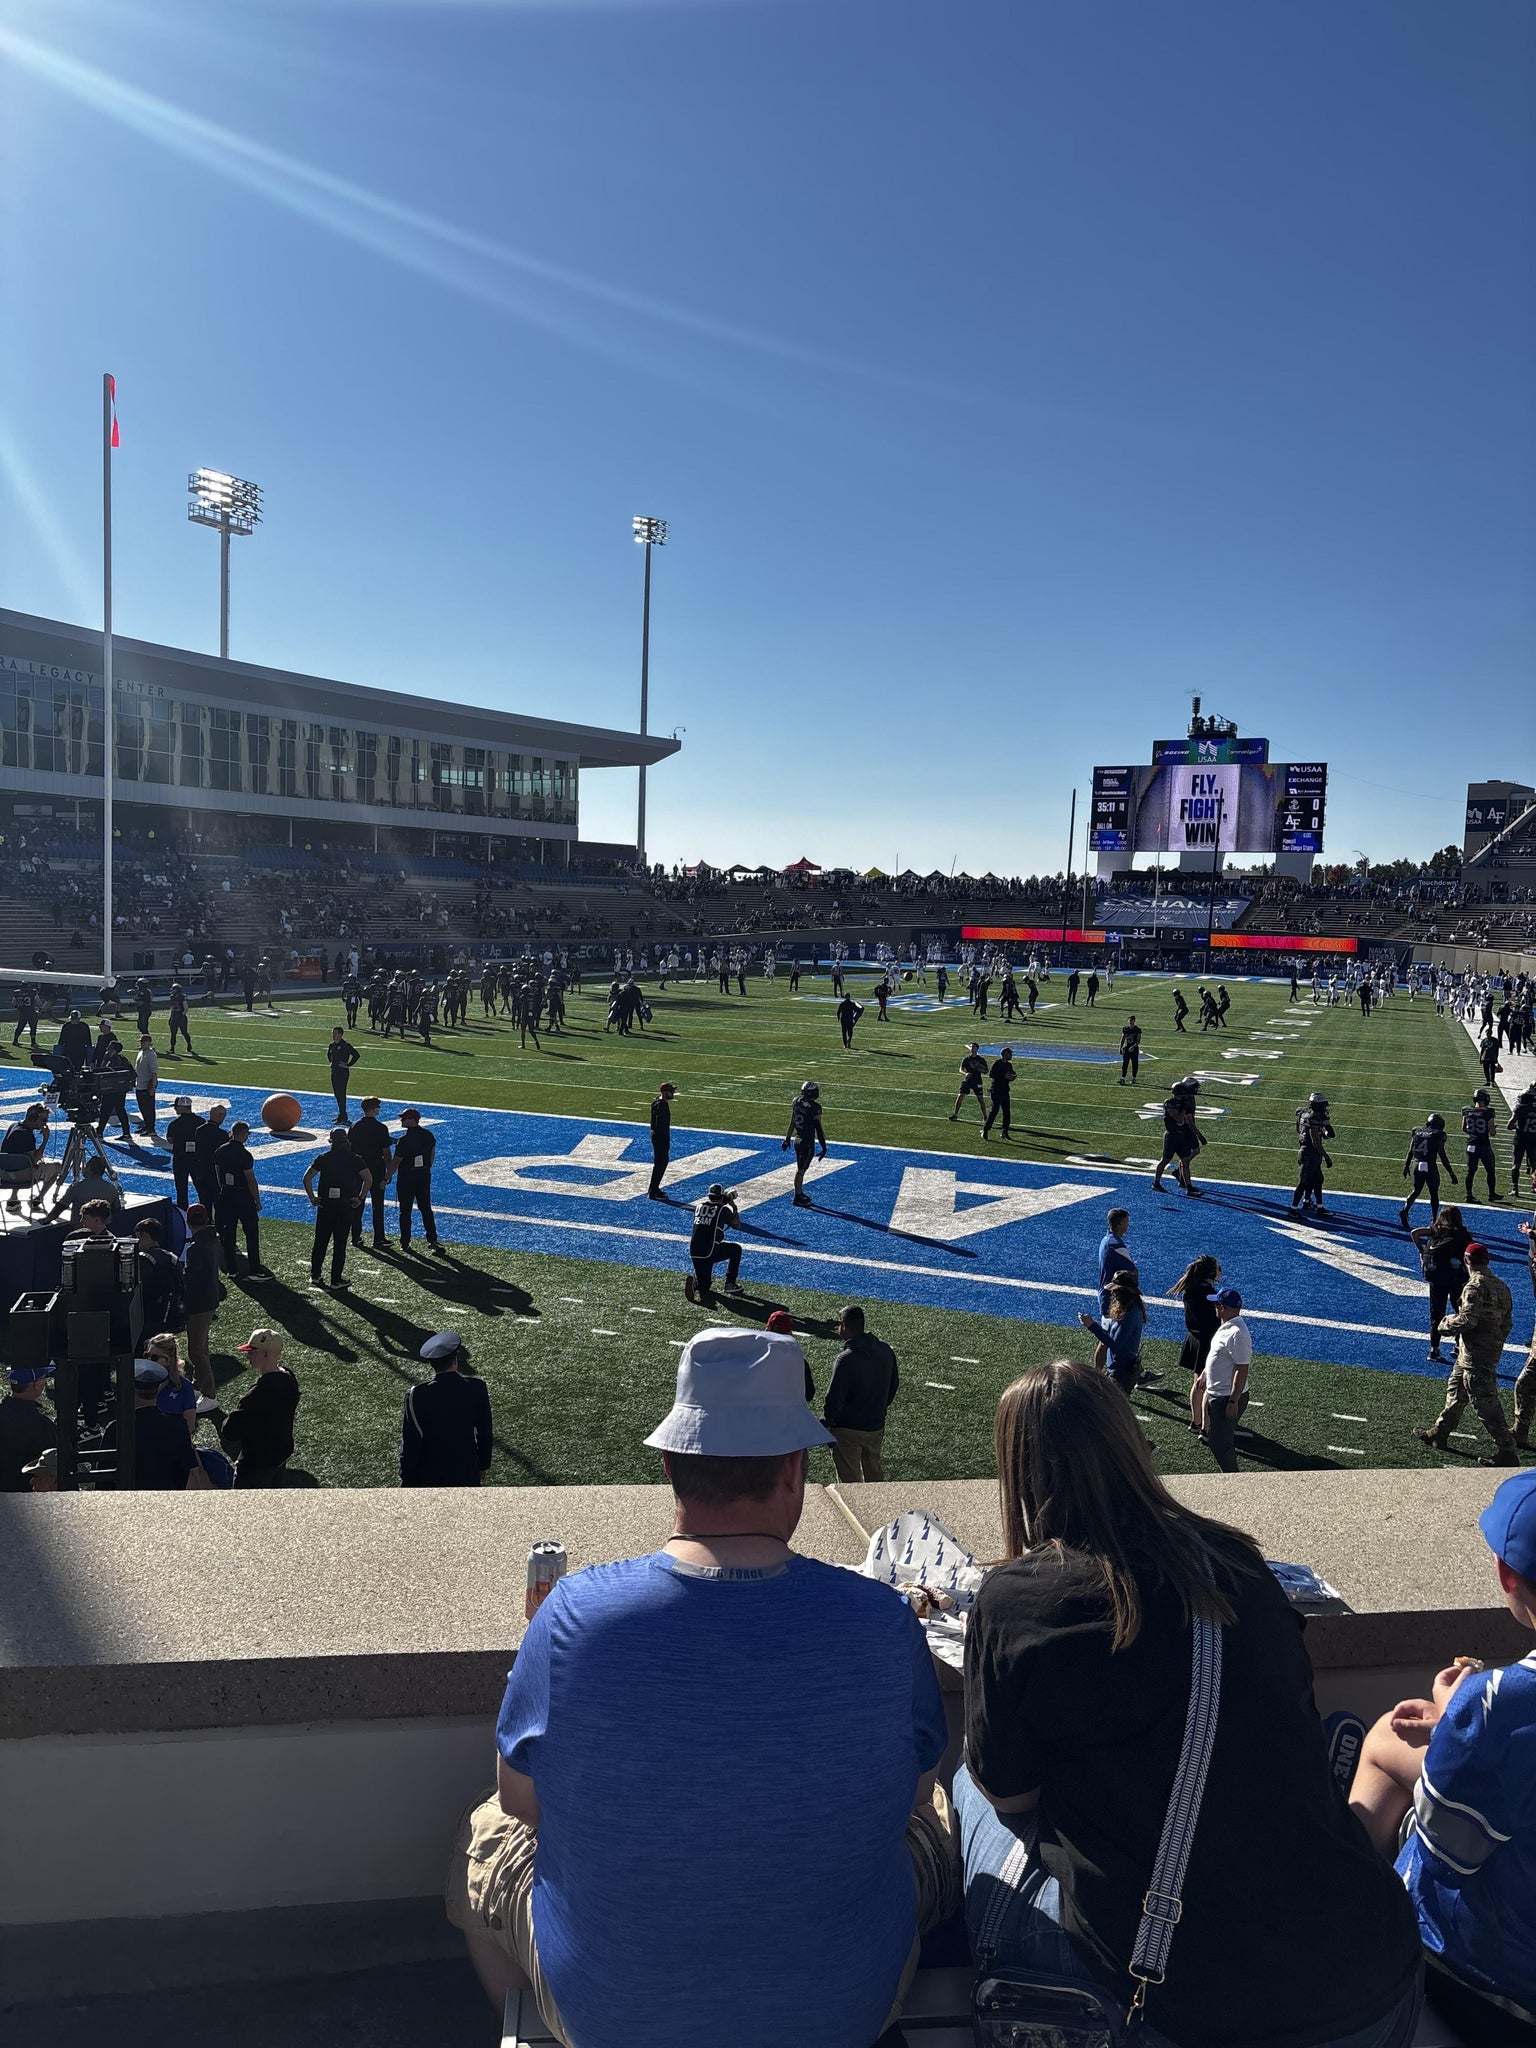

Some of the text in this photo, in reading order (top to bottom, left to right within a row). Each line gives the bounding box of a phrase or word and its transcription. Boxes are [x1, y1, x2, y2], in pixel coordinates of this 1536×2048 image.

[29, 661, 94, 685] LEGACY
[107, 678, 165, 697] ENTER
[1191, 774, 1219, 796] FLY.
[1097, 801, 1115, 812] 35:11
[1180, 798, 1228, 820] FIGHT.
[1312, 798, 1320, 811] 0
[1311, 816, 1318, 829] 0
[1185, 823, 1219, 845] WIN
[1172, 930, 1185, 940] 25
[729, 1567, 764, 1580] FORCE
[1333, 1733, 1359, 1779] ONE
